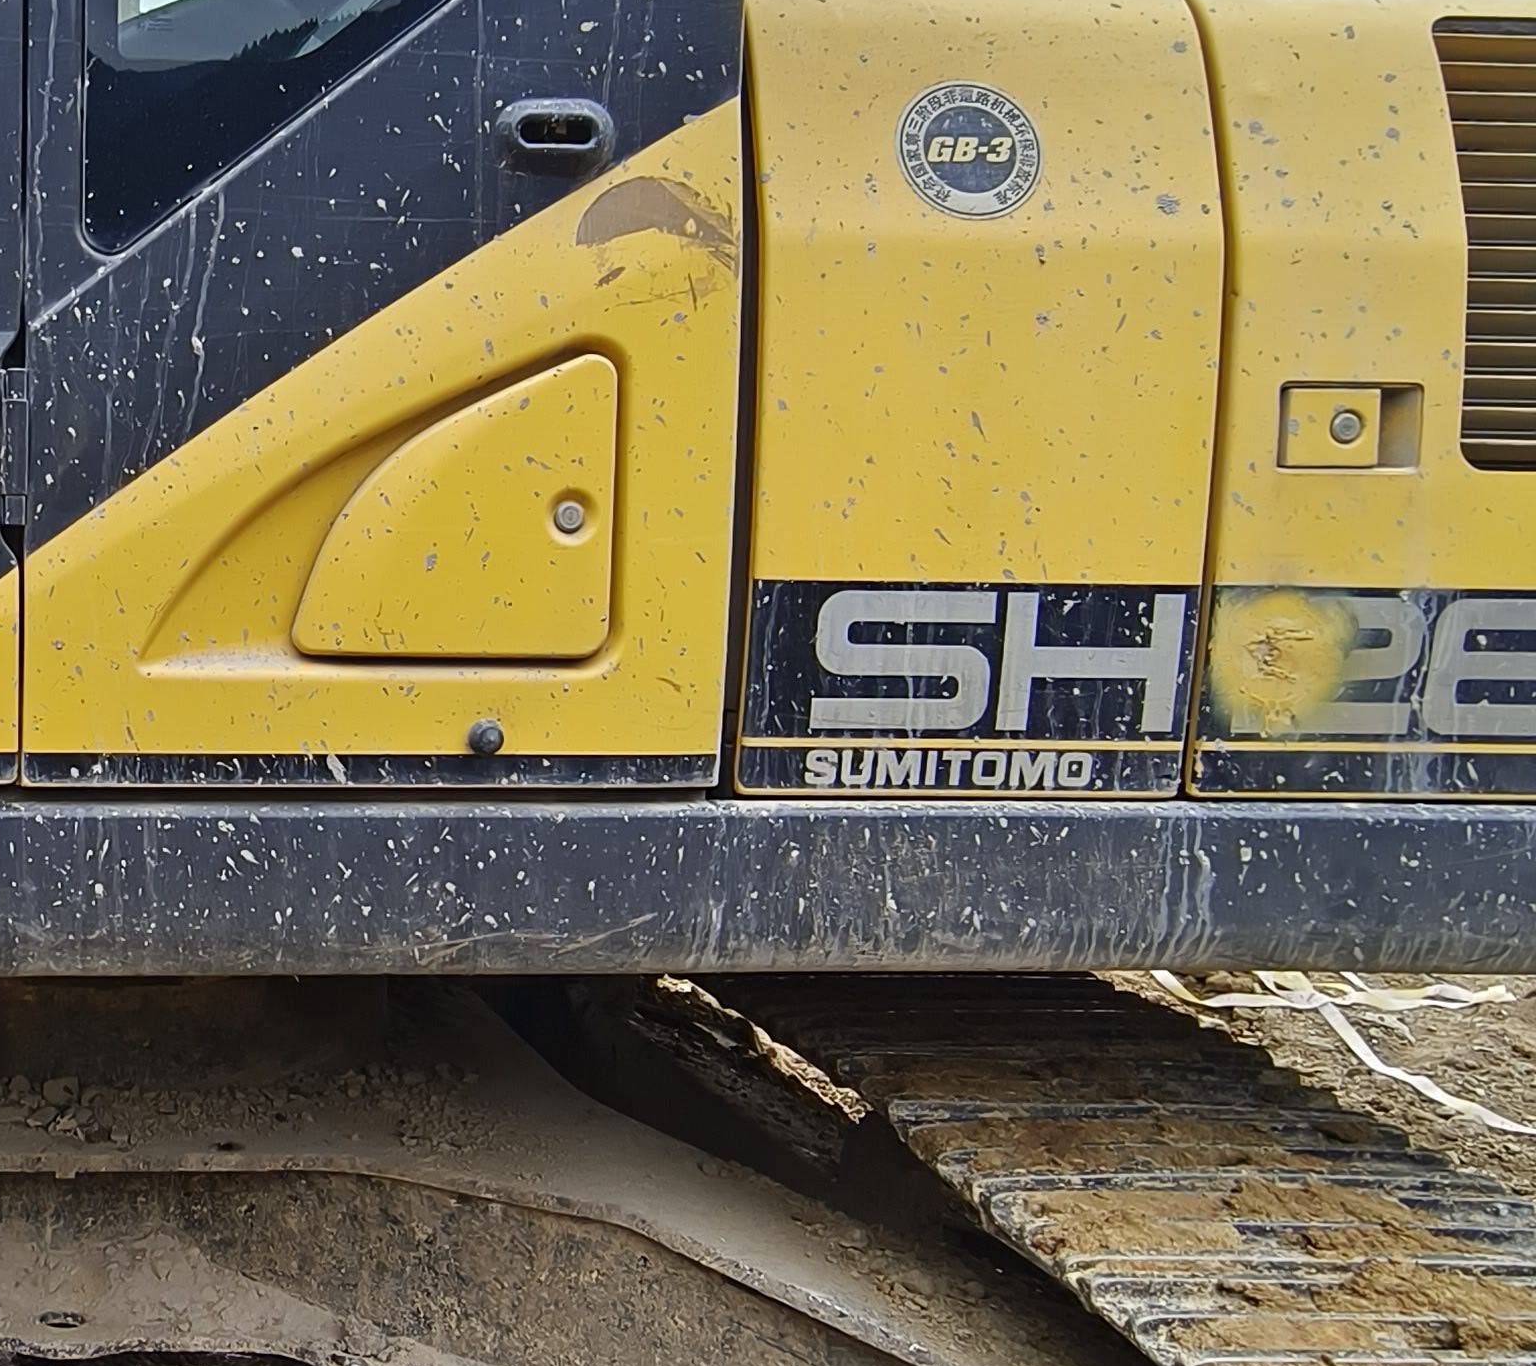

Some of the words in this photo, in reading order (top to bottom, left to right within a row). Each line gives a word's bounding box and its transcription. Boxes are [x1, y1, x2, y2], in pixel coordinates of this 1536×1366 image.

[927, 136, 1013, 163] GB-3
[809, 590, 1187, 733] SH
[804, 749, 1093, 789] SUMITOMO
